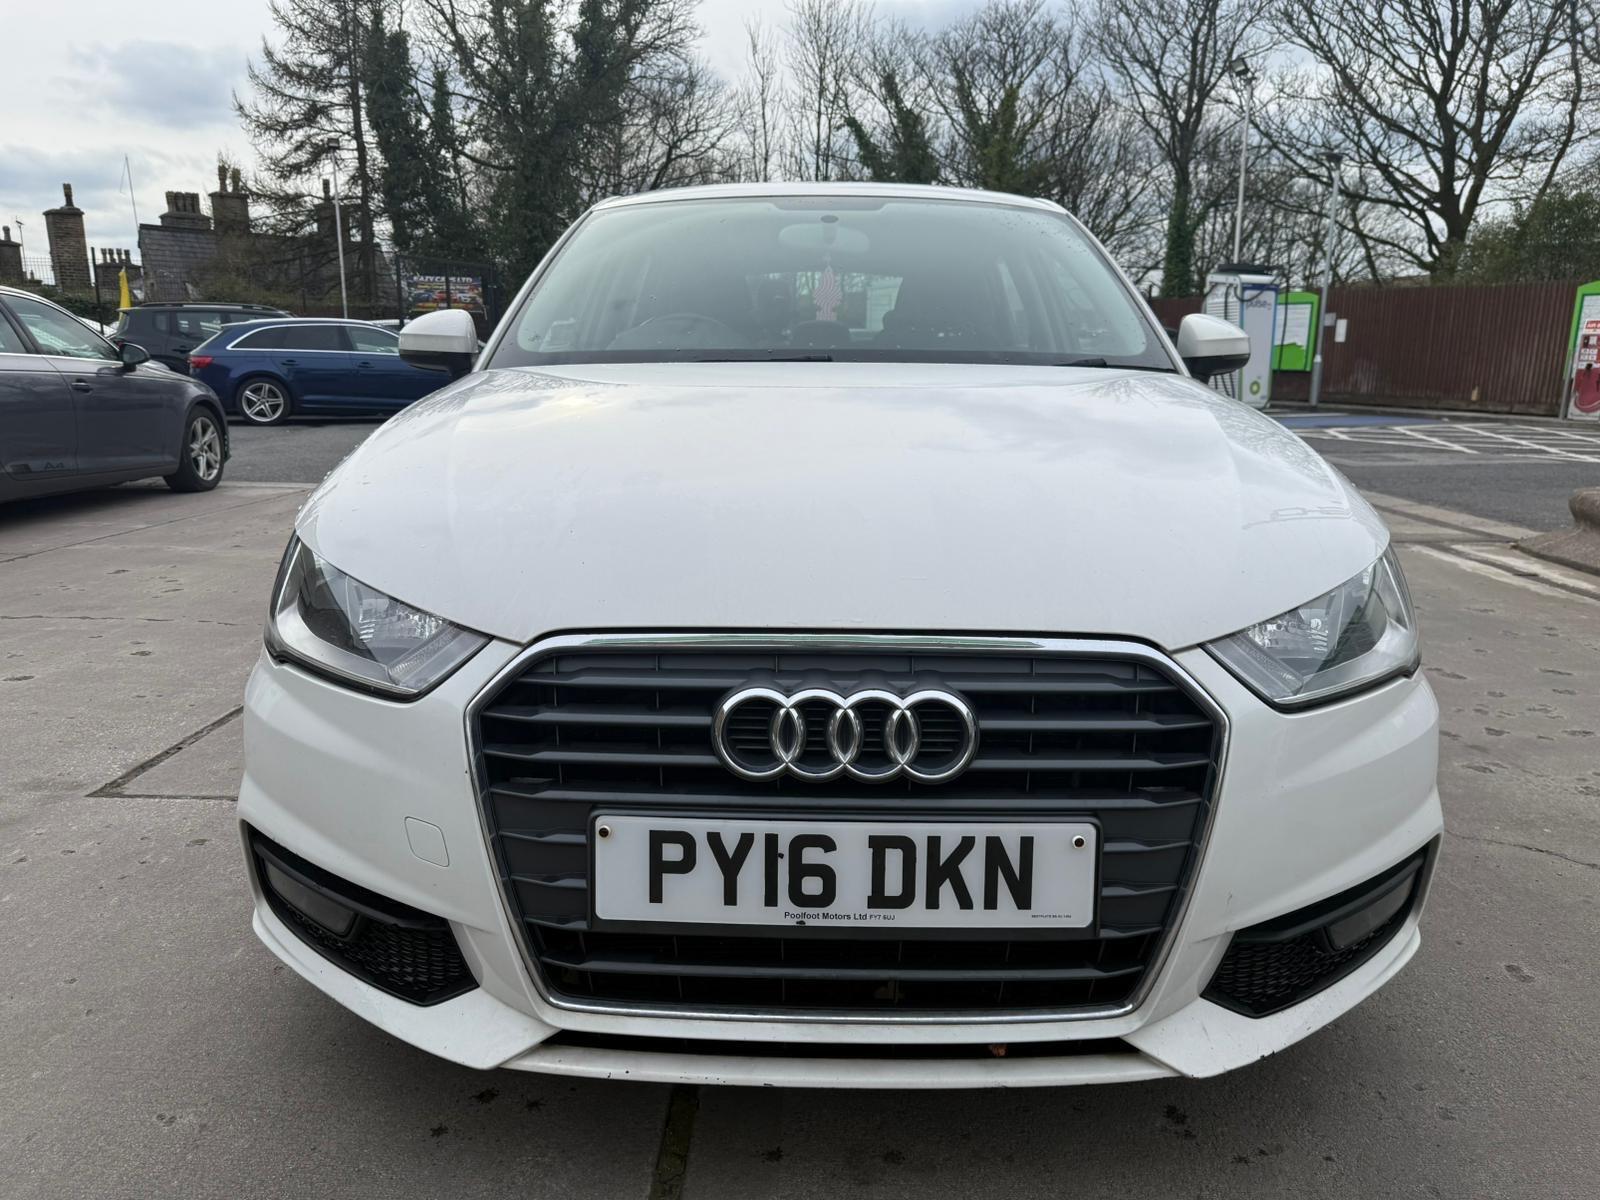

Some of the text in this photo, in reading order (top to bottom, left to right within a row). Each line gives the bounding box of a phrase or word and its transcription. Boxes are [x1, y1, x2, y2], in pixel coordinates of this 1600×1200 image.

[649, 829, 1034, 910] PY16 DKN
[784, 911, 820, 920] Poolfoot
[822, 912, 851, 920] Motors
[853, 913, 867, 921] Ltd
